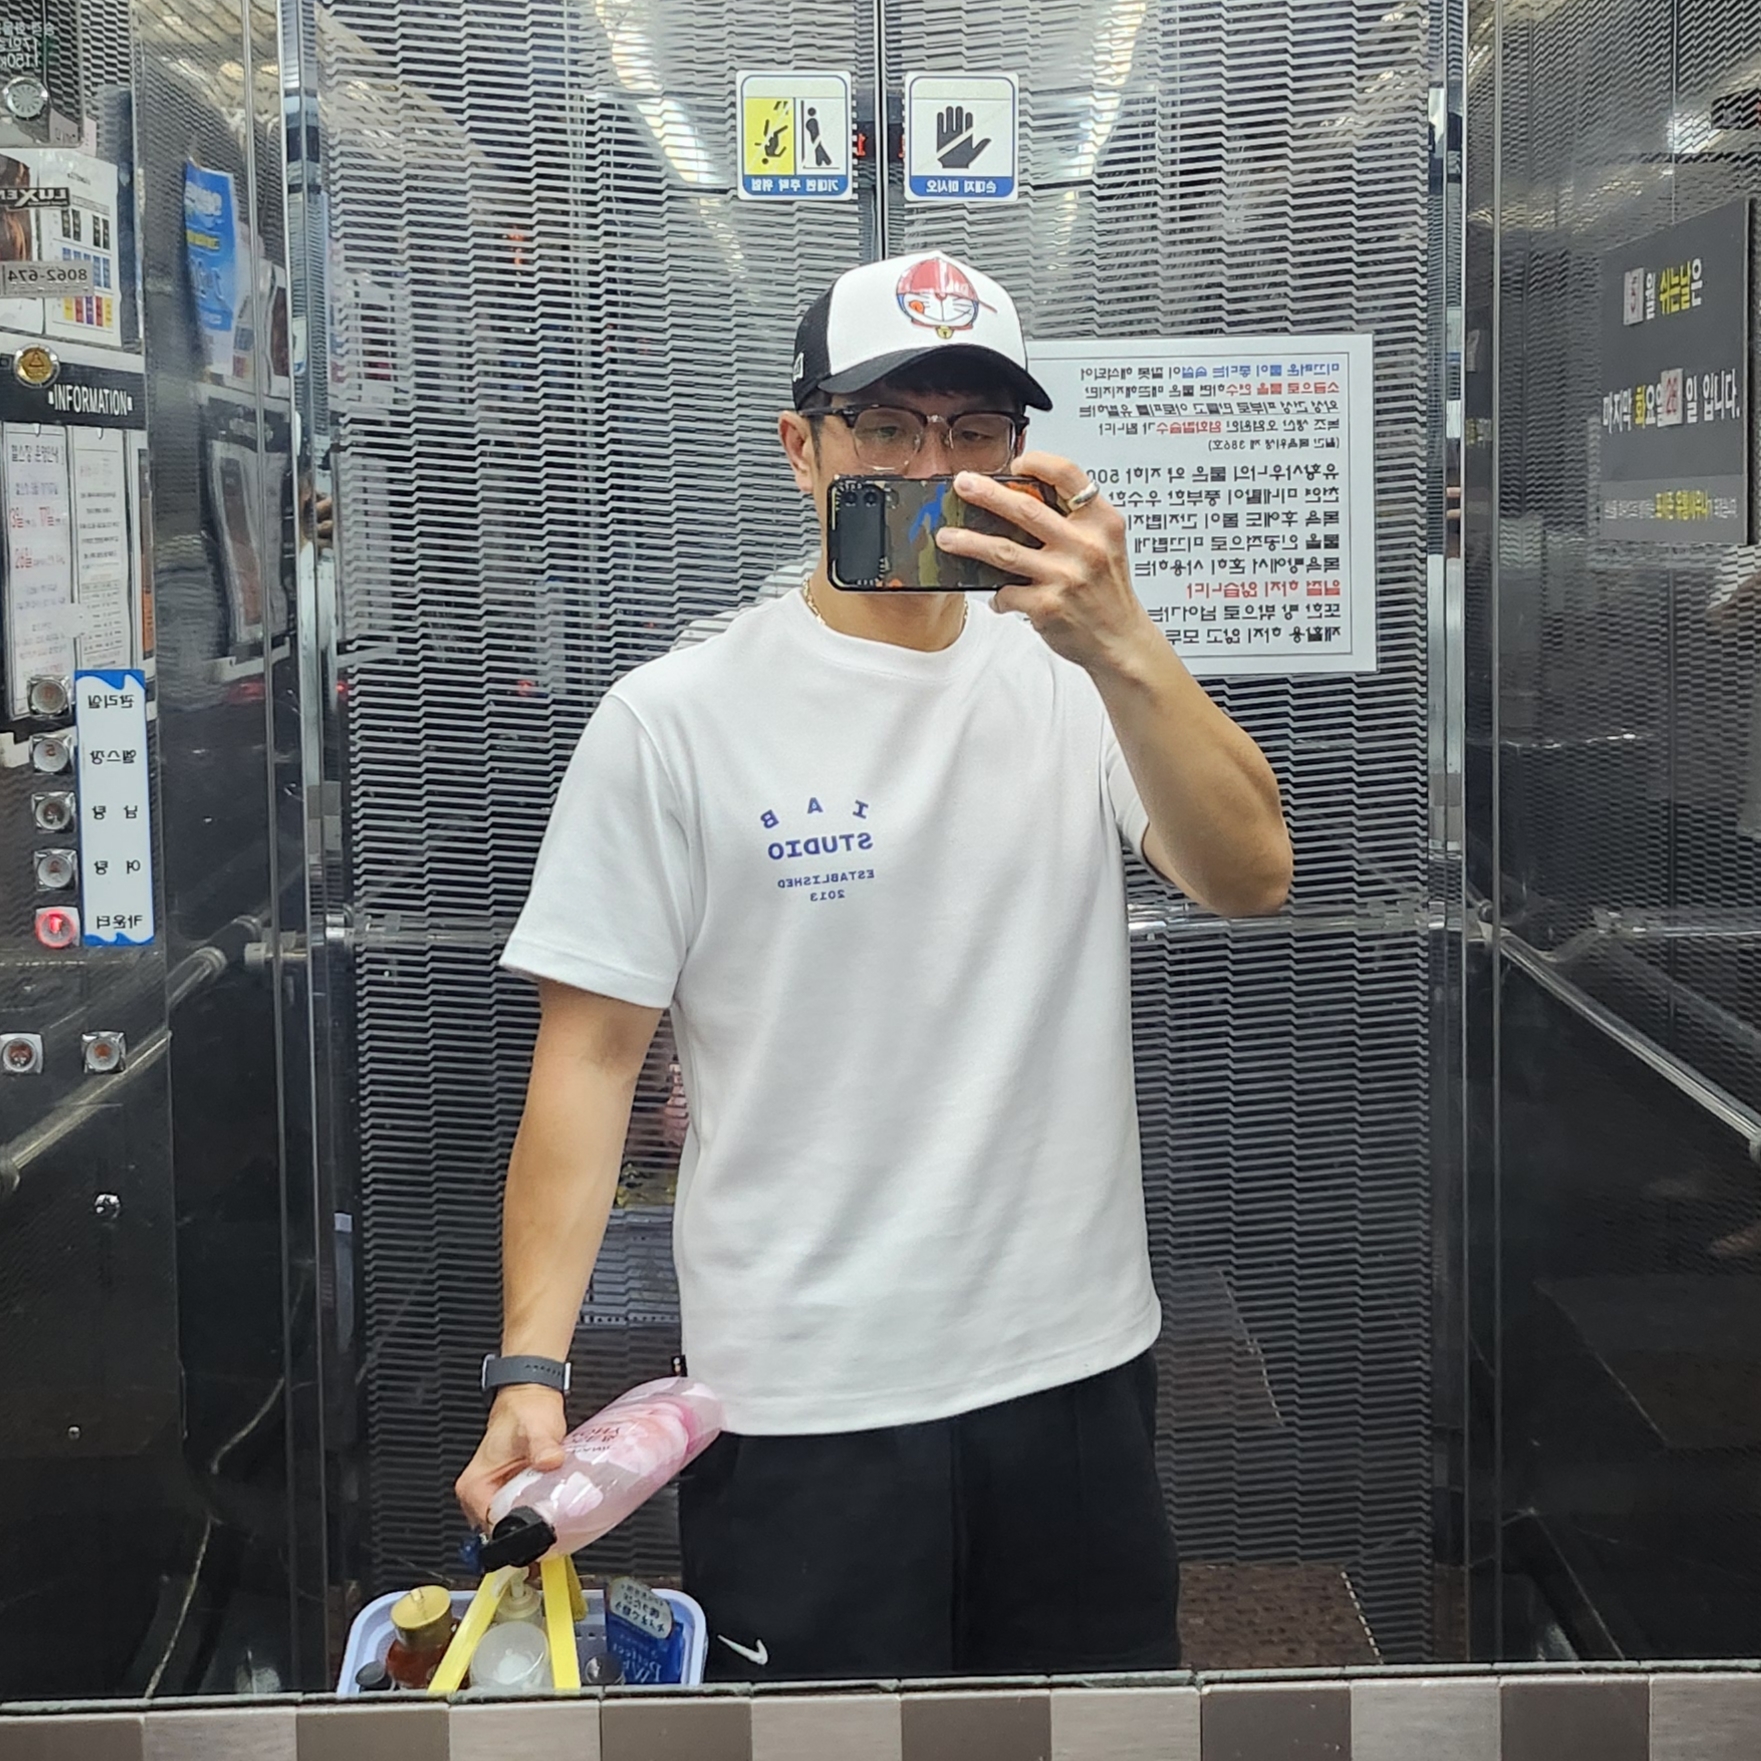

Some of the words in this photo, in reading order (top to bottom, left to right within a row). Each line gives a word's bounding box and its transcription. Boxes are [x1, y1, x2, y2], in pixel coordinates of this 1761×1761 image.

[1659, 258, 1702, 314] 쉬는날은
[54, 384, 127, 416] INFORMATION
[1602, 388, 1632, 434] 마지막
[1634, 384, 1664, 427] 화요일
[1685, 374, 1698, 423] 일
[1702, 368, 1741, 420] 입니다.
